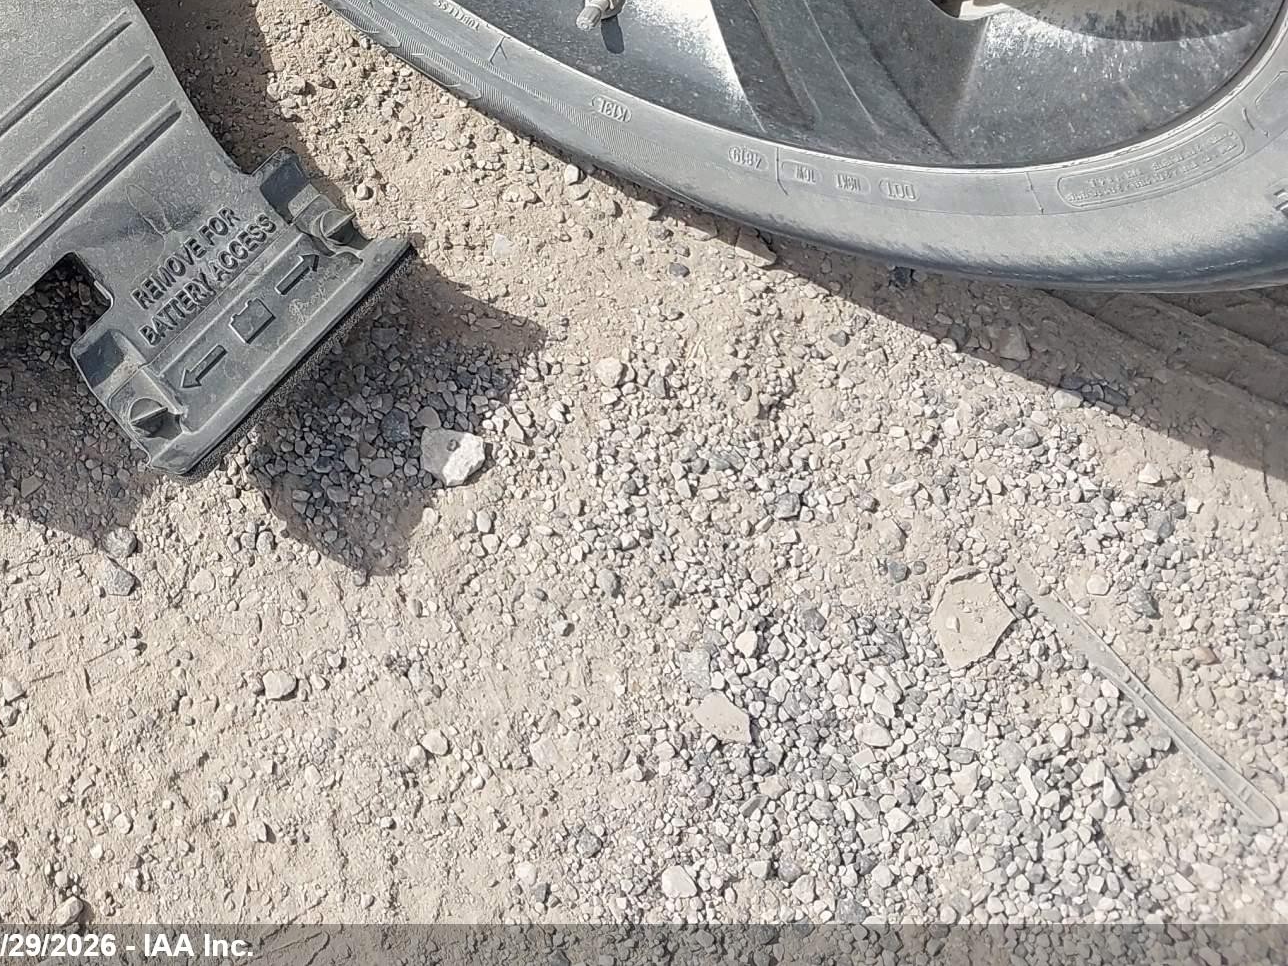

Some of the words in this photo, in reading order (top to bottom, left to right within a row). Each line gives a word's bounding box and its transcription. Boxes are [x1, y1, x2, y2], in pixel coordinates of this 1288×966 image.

[732, 147, 763, 170] 4819
[886, 181, 916, 200] DOT
[131, 235, 206, 311] REMOVE
[199, 207, 242, 248] FOR
[138, 270, 217, 347] BATTERY
[207, 212, 278, 284] ACCESS
